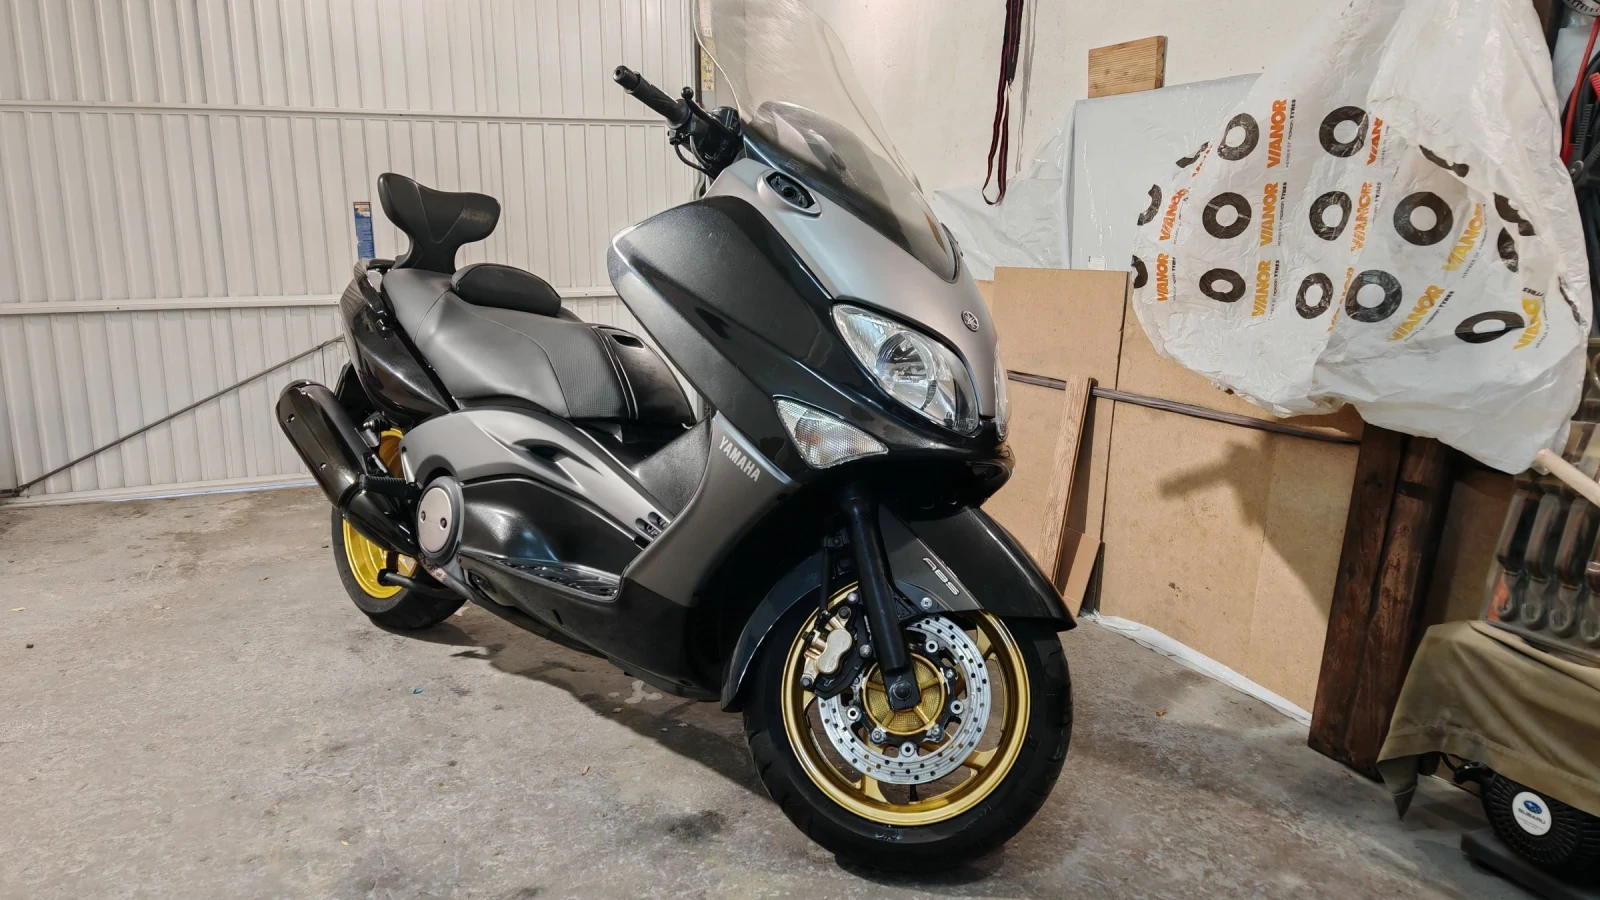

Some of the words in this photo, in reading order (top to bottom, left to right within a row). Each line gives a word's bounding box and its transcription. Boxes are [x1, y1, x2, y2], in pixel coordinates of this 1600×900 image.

[1267, 98, 1287, 169] VIANOR
[1366, 117, 1384, 166] VIAN
[1260, 182, 1279, 247] VIANOR
[1349, 181, 1373, 251] VIANOR
[1156, 252, 1169, 302] VIANOR
[1251, 259, 1272, 317] VIANOR
[1438, 291, 1455, 308] TYRES
[1386, 285, 1446, 342] VIANOR
[719, 435, 761, 482] YAMAHA
[922, 557, 960, 595] ABS
